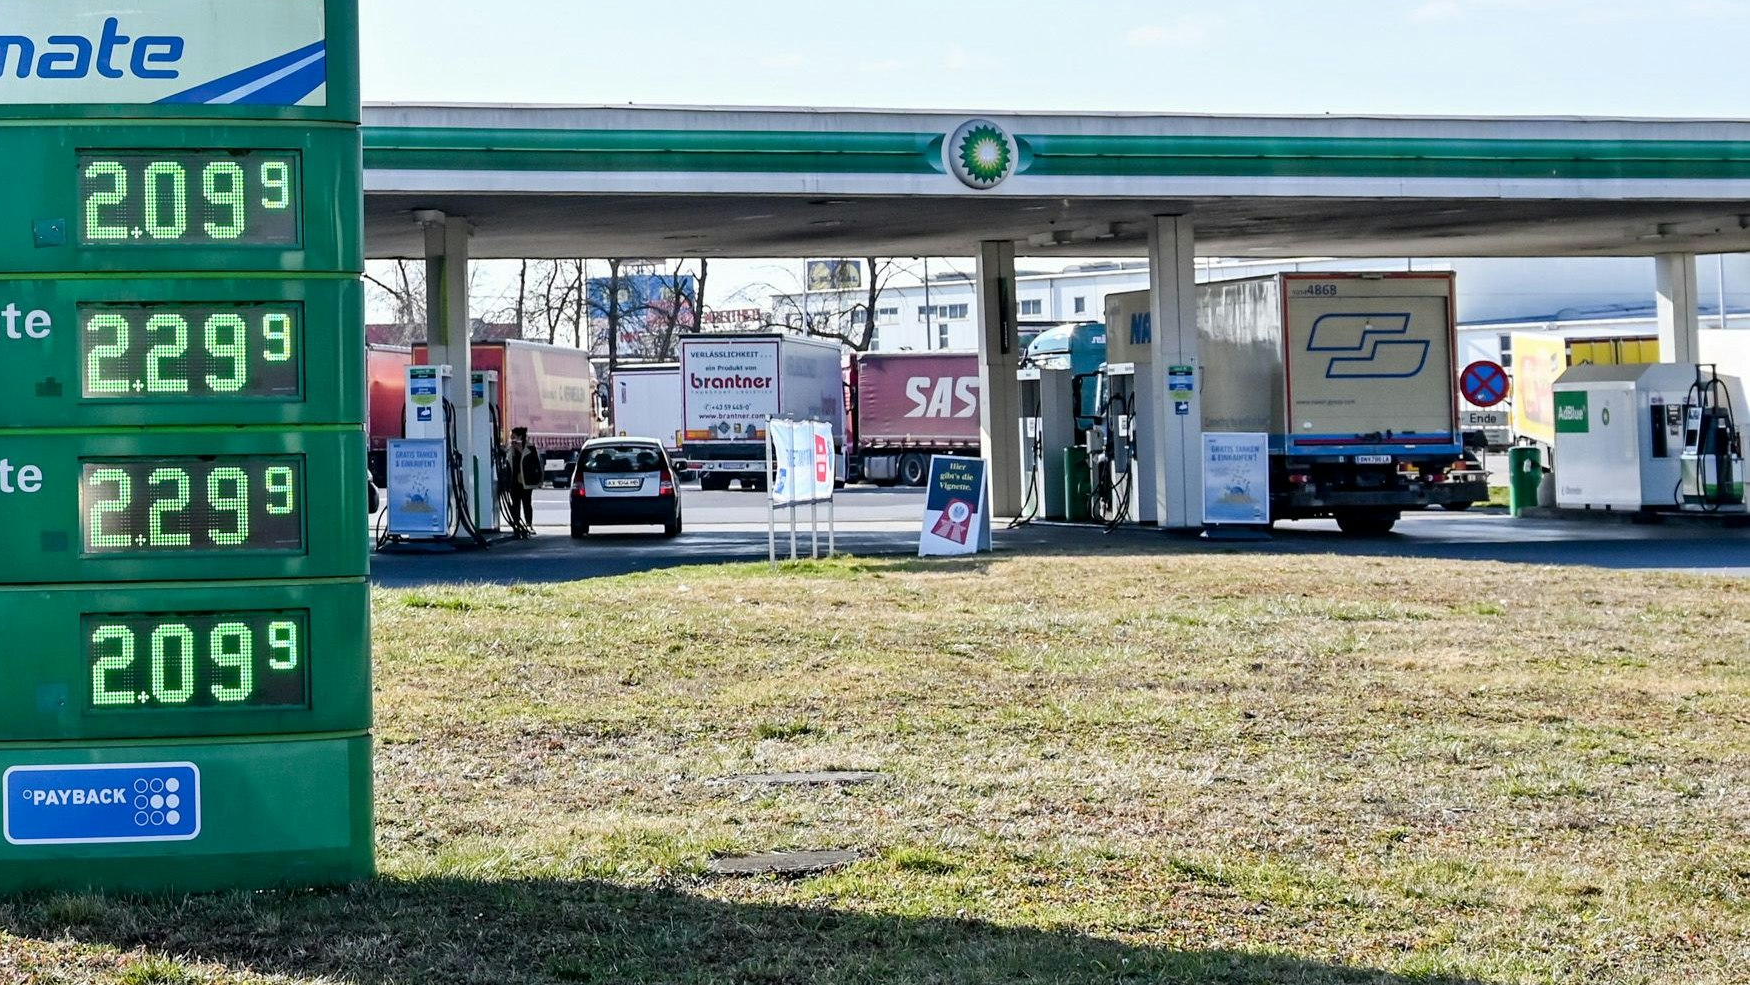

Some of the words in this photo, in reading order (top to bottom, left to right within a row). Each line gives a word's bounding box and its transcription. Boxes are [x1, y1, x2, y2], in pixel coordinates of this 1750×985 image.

[690, 372, 772, 389] brantner
[1469, 413, 1497, 424] Ende
[950, 462, 967, 471] Hier
[961, 473, 974, 481] die
[33, 787, 127, 807] PAYBACK
